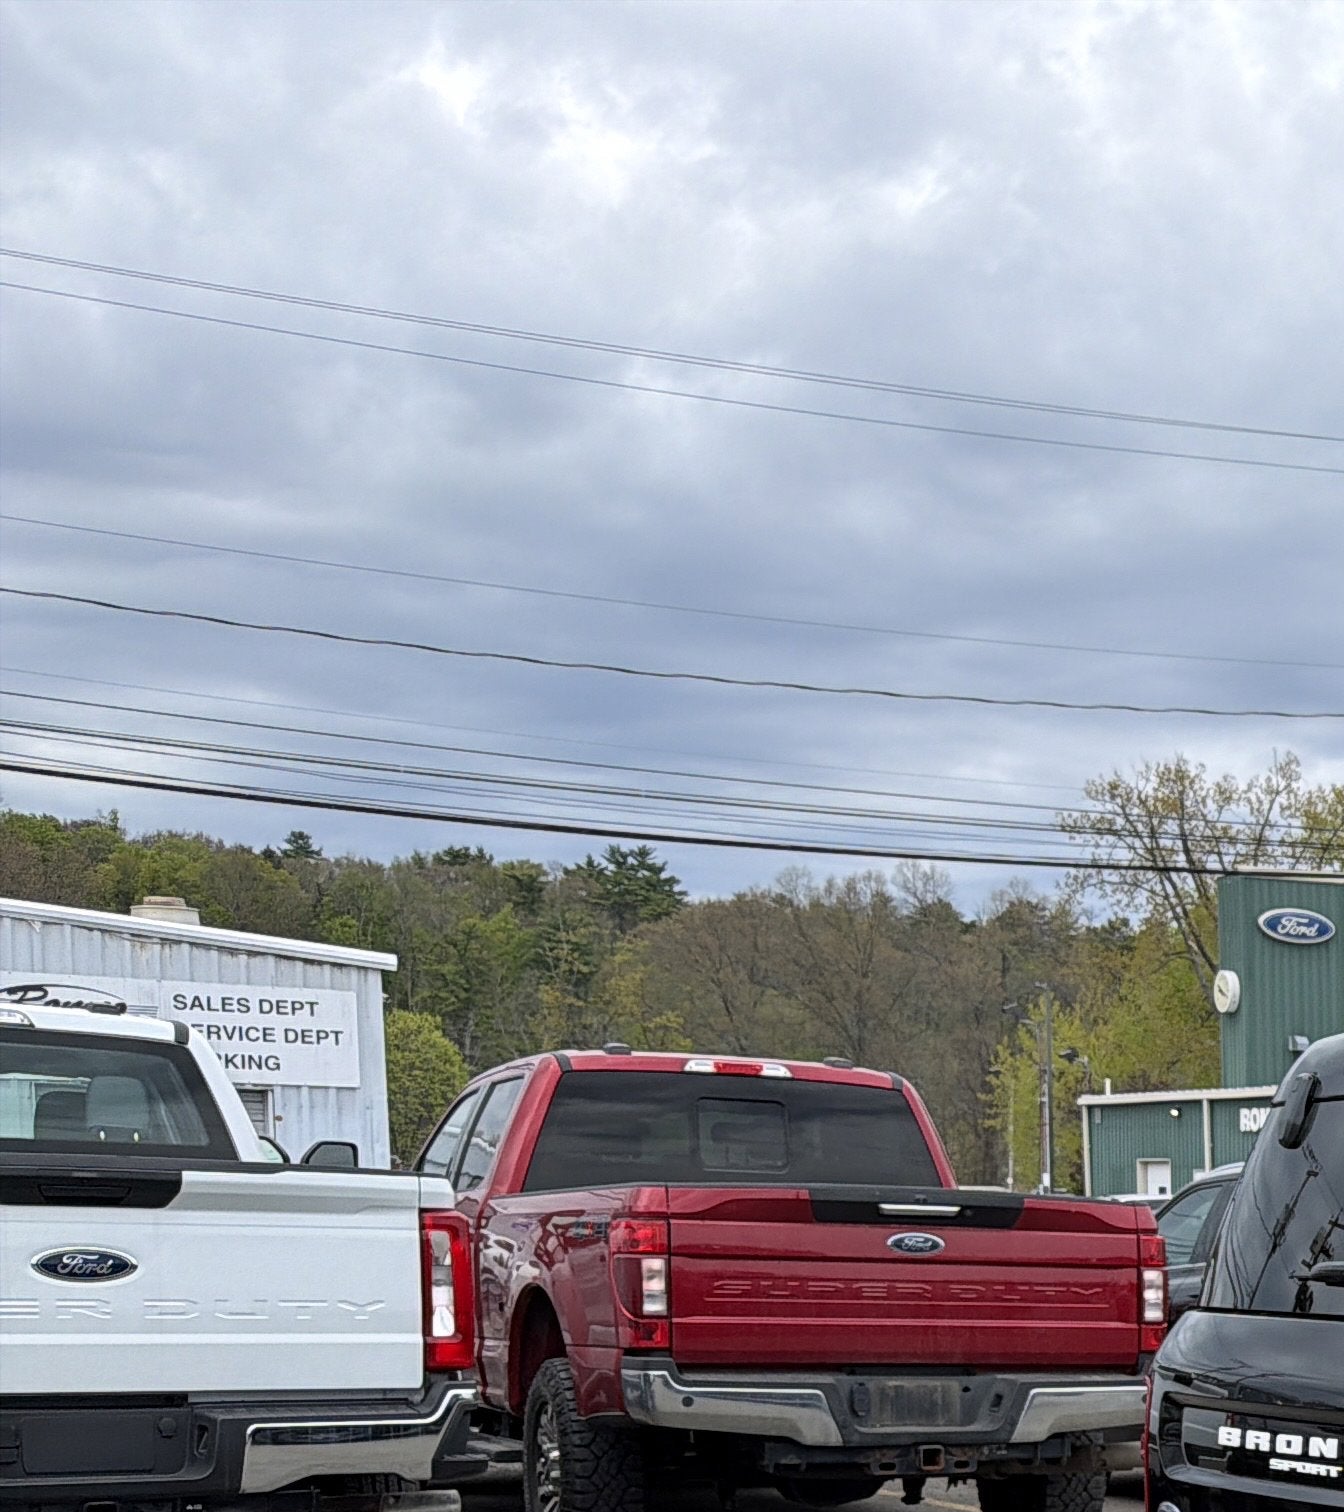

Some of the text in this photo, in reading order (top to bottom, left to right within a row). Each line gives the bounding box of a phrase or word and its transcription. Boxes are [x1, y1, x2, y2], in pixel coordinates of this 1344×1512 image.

[1276, 915, 1319, 937] Ford
[172, 994, 319, 1018] SALES DEPT
[284, 1027, 345, 1047] DEPT
[218, 1053, 281, 1071] KING
[901, 1236, 933, 1251] Ford
[56, 1253, 114, 1274] Ford
[713, 1280, 1103, 1301] SUPER DUTY
[143, 1298, 386, 1320] DUTY
[1268, 1457, 1343, 1478] SPORT
